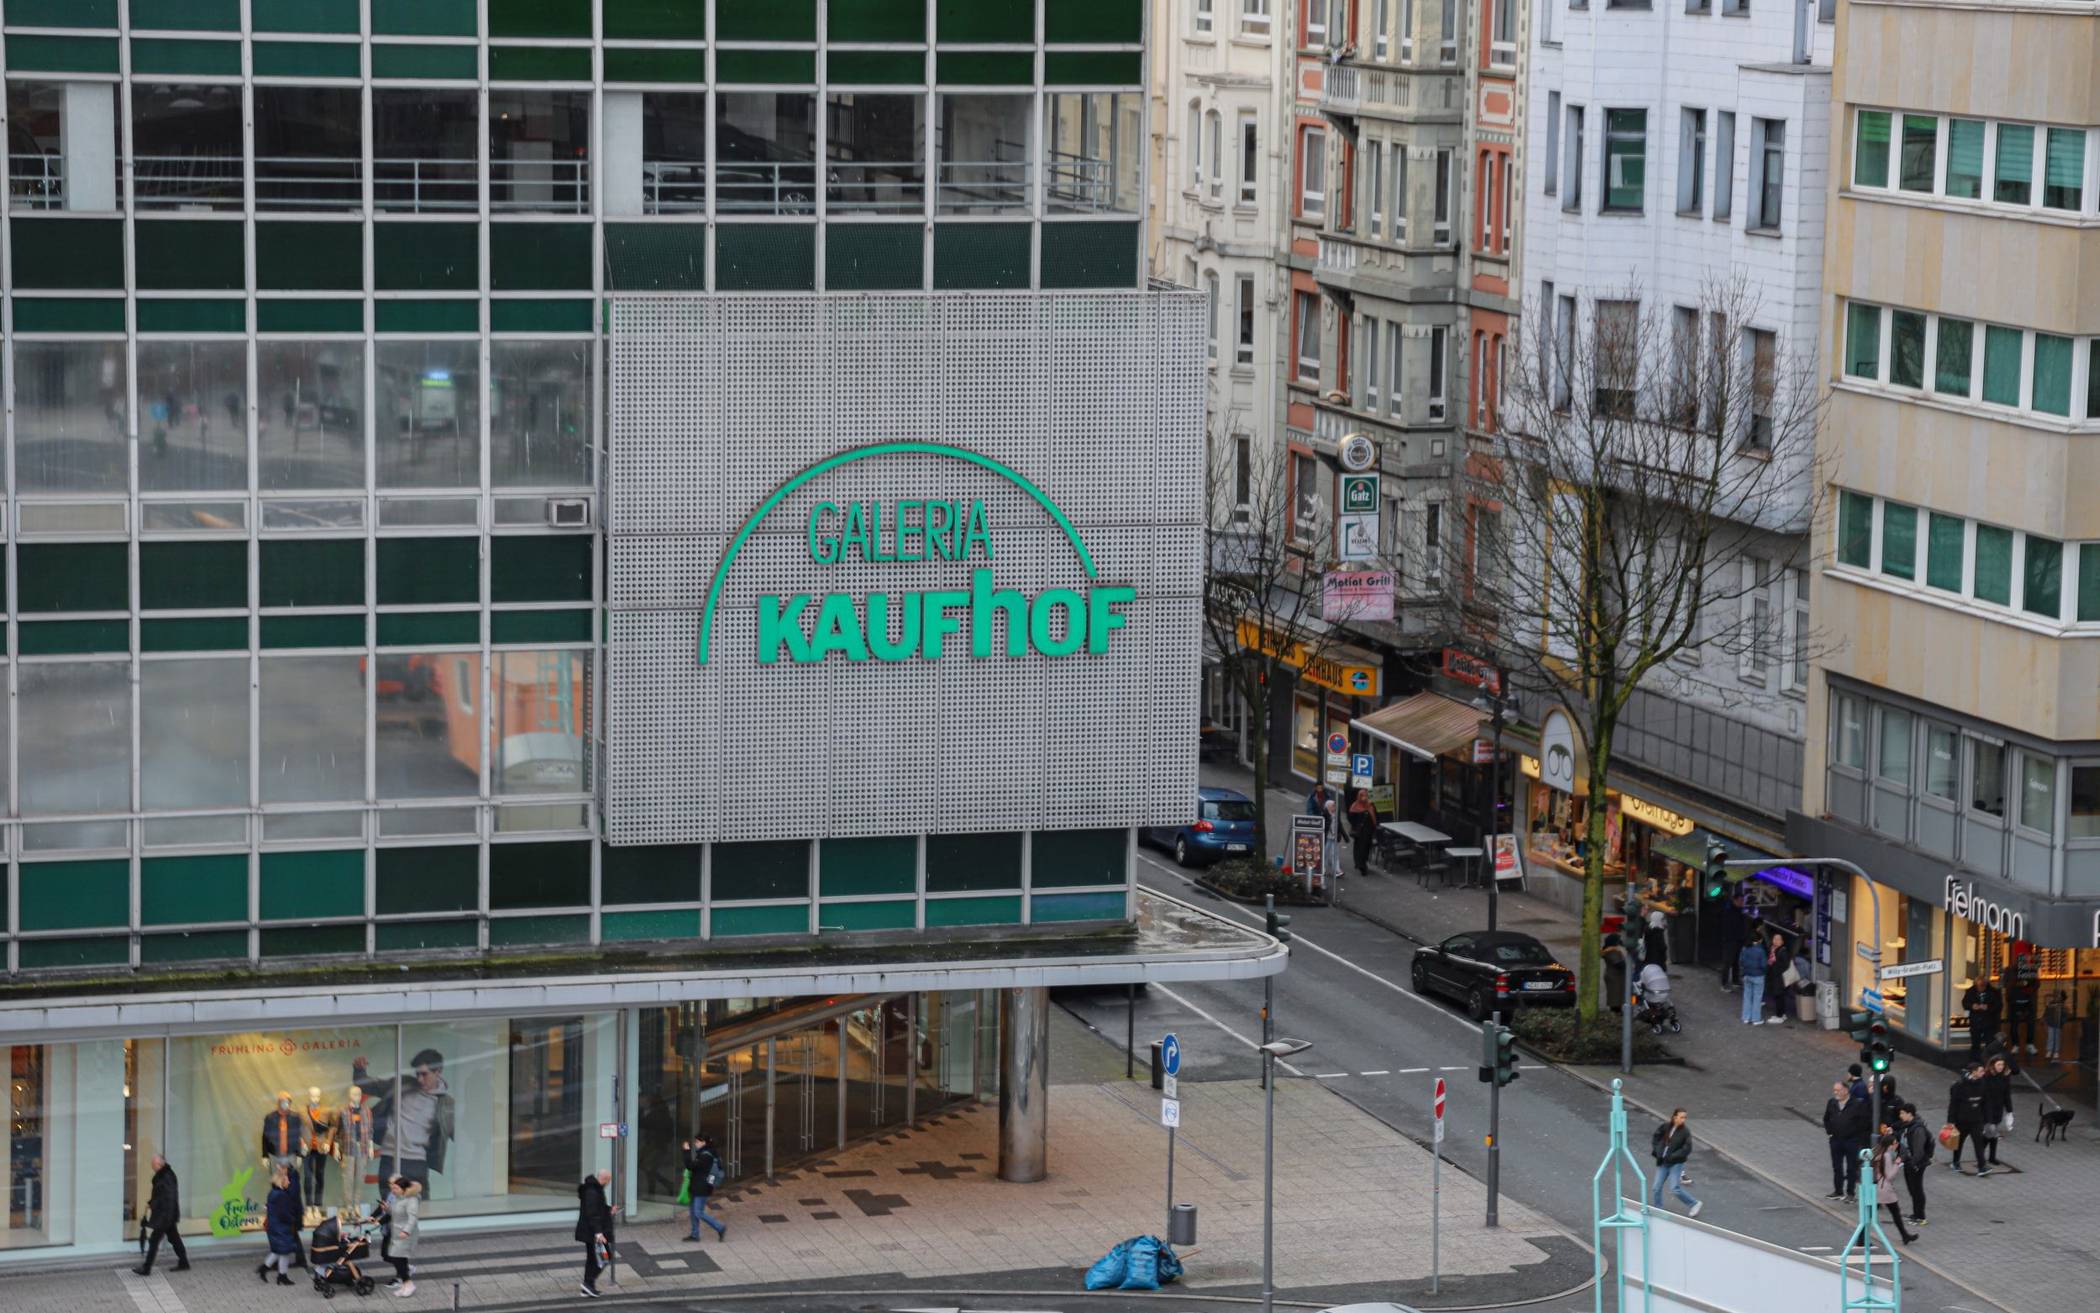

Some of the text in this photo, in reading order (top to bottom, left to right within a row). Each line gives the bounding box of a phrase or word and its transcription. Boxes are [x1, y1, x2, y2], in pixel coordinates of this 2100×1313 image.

[1351, 489, 1370, 502] Gatz
[808, 498, 994, 565] GALERIA
[1367, 576, 1391, 586] Grill
[1357, 757, 1369, 774] P
[302, 1039, 361, 1051] GALERIA
